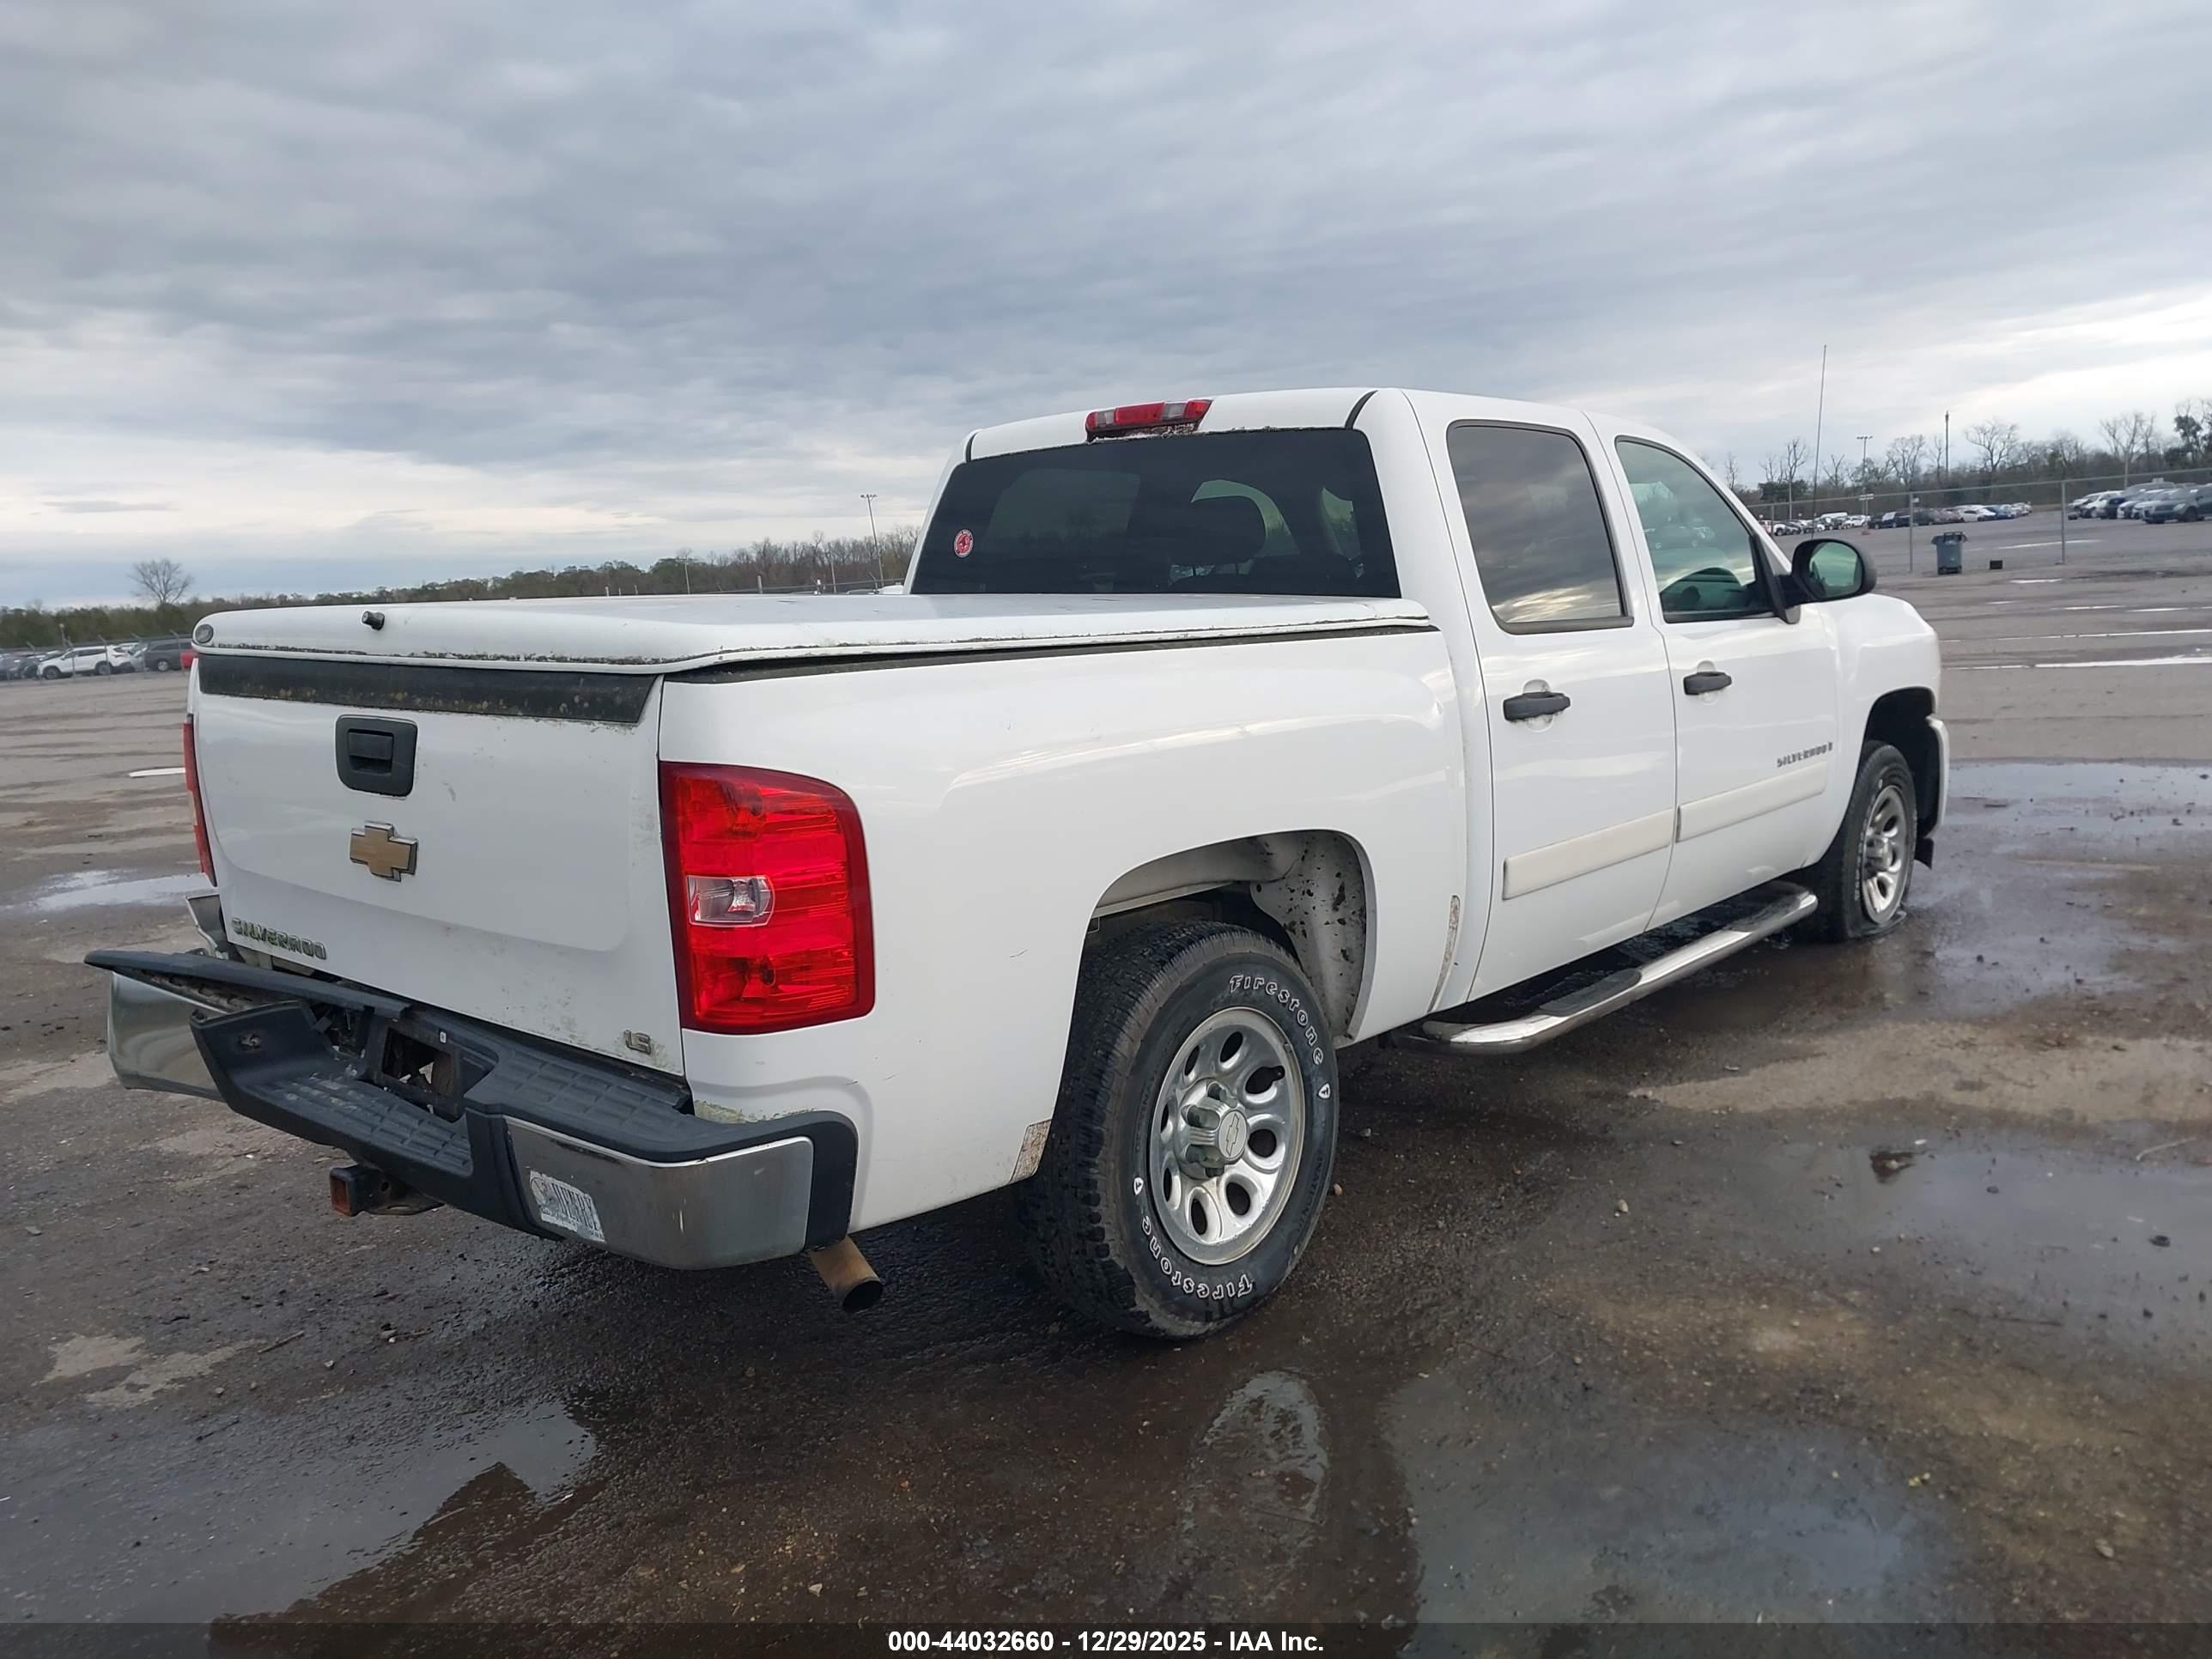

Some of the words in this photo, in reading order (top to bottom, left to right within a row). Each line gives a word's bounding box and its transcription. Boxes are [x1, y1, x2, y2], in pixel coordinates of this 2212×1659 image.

[1777, 744, 1828, 769] SILVERADO
[231, 916, 328, 961] SILVERADO
[1229, 974, 1324, 1065] Firestone
[623, 1030, 652, 1055] LS
[1142, 1215, 1254, 1300] Firestone
